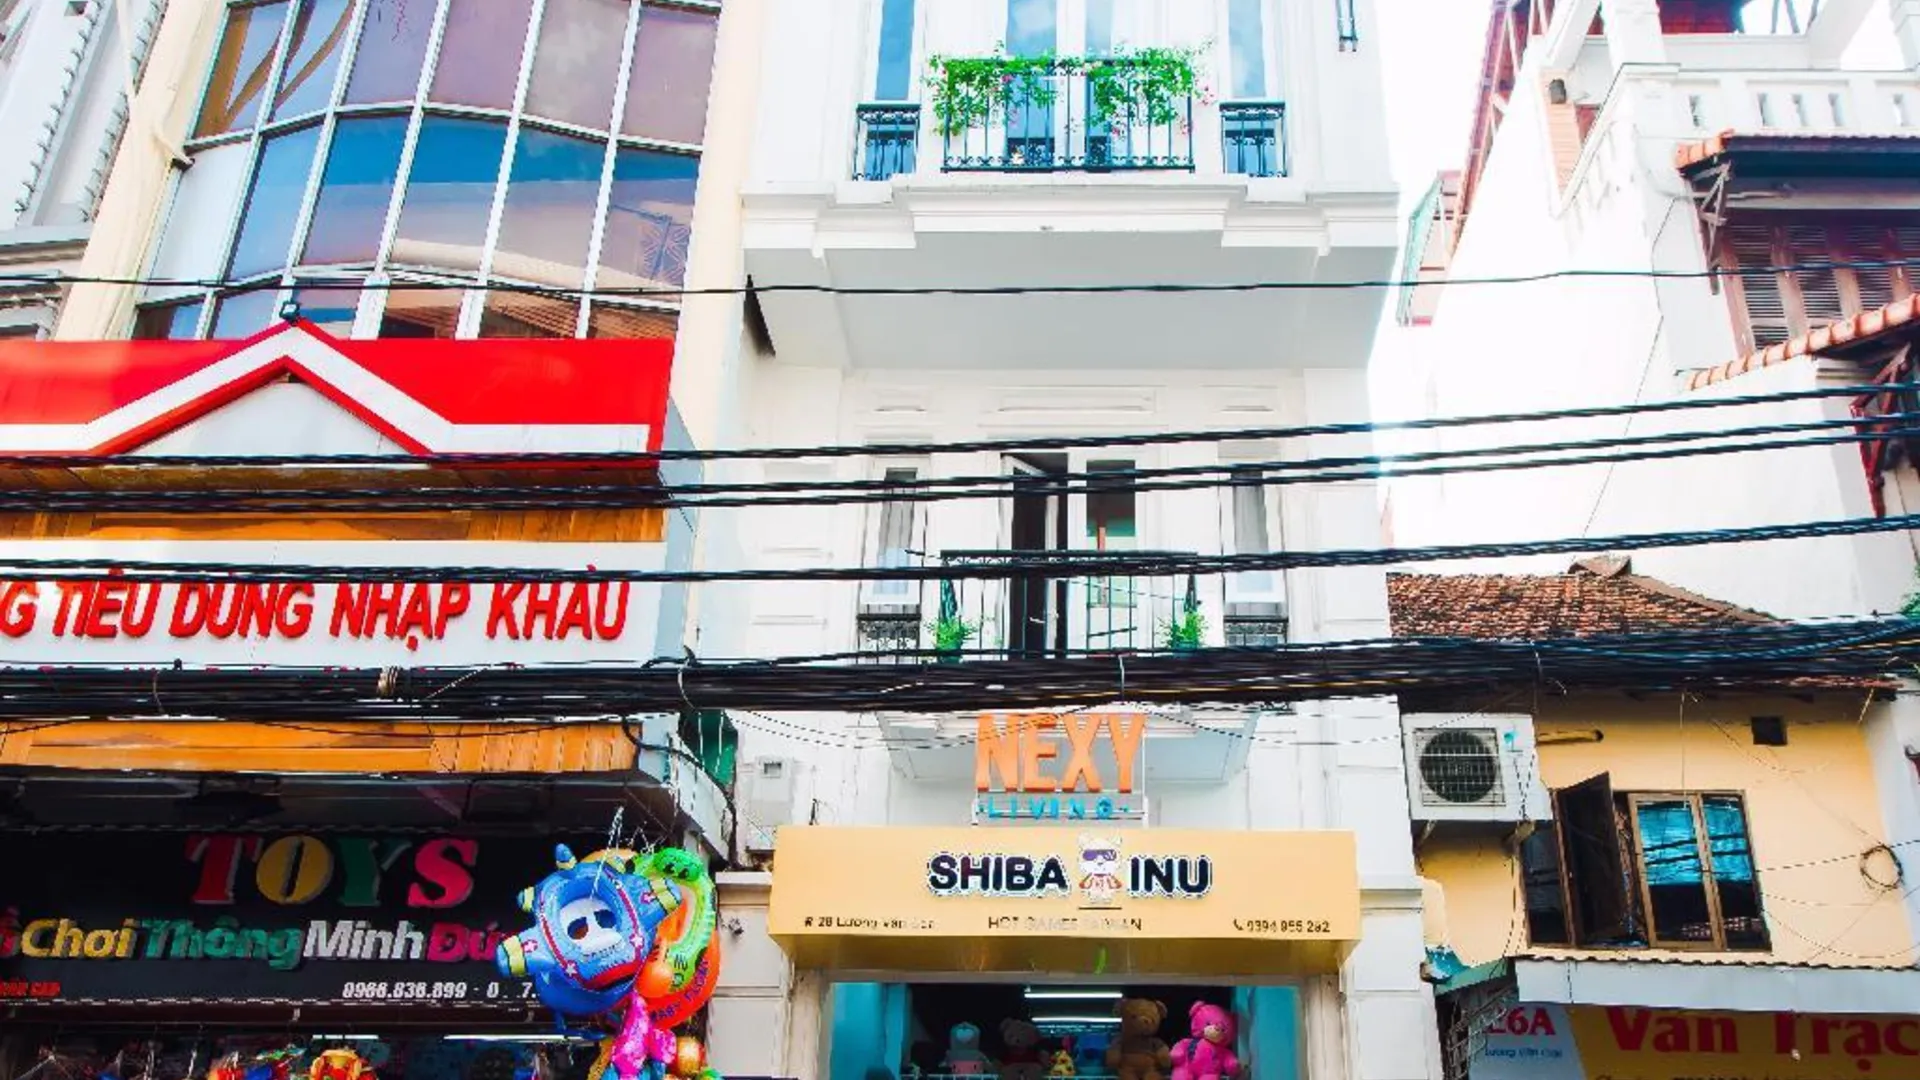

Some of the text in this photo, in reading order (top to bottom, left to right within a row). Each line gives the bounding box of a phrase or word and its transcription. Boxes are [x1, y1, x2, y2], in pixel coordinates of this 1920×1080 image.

[976, 712, 1146, 793] NEXY
[185, 834, 478, 908] TOYS
[927, 853, 1213, 897] SHIBA INU
[303, 919, 424, 960] Minh
